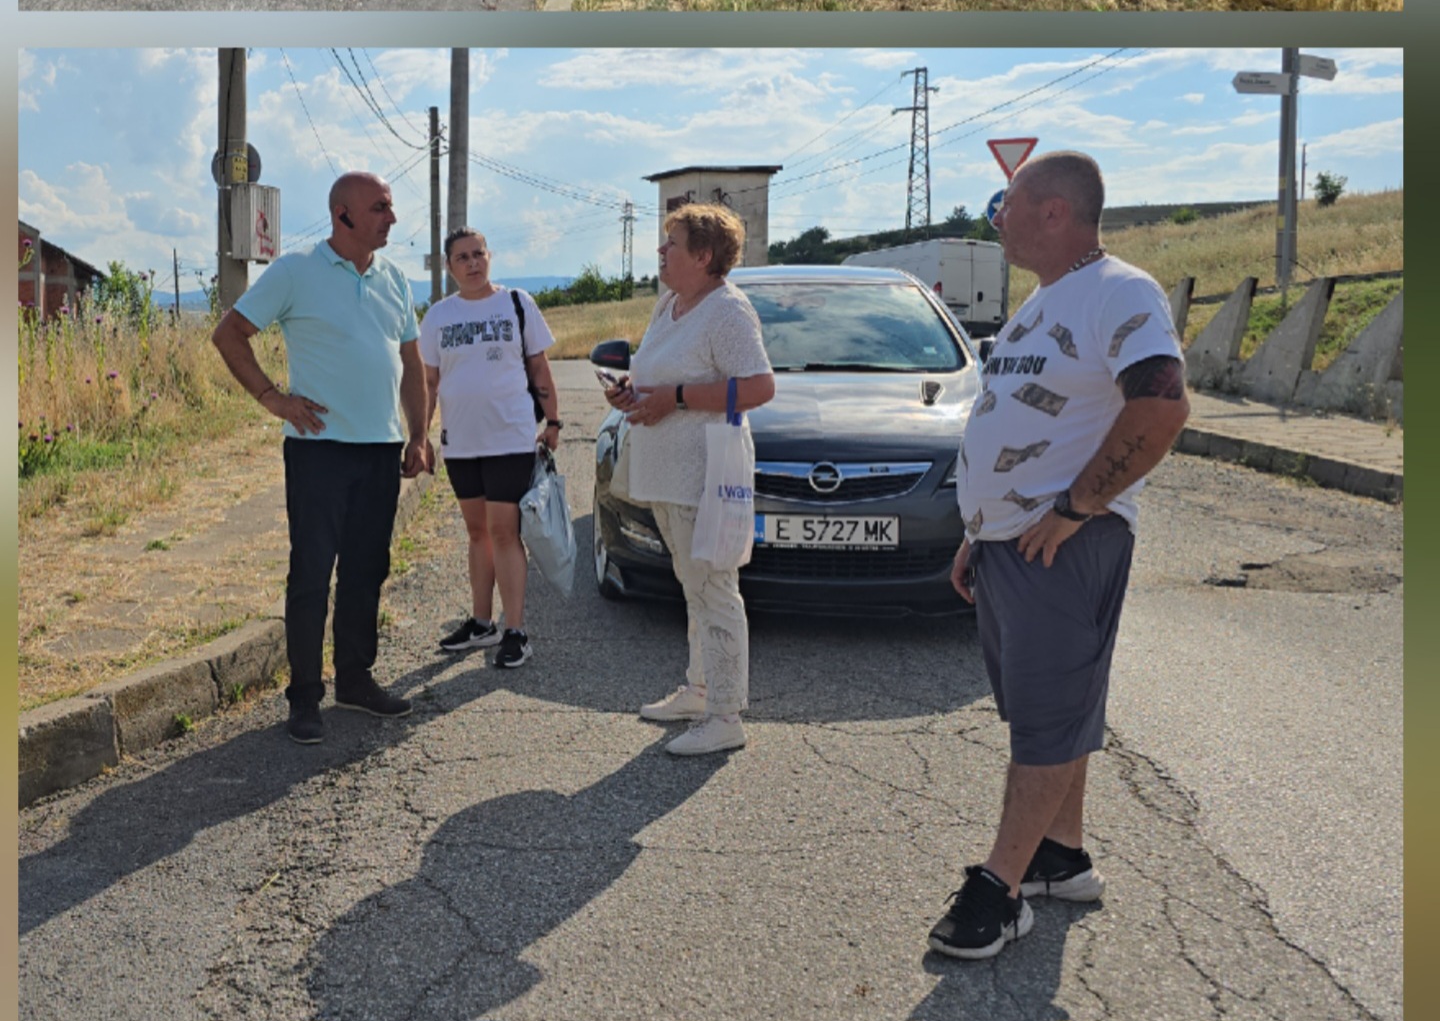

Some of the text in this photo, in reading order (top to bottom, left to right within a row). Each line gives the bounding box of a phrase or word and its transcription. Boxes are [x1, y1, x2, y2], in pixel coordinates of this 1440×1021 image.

[776, 519, 892, 542] E 5727 MK
